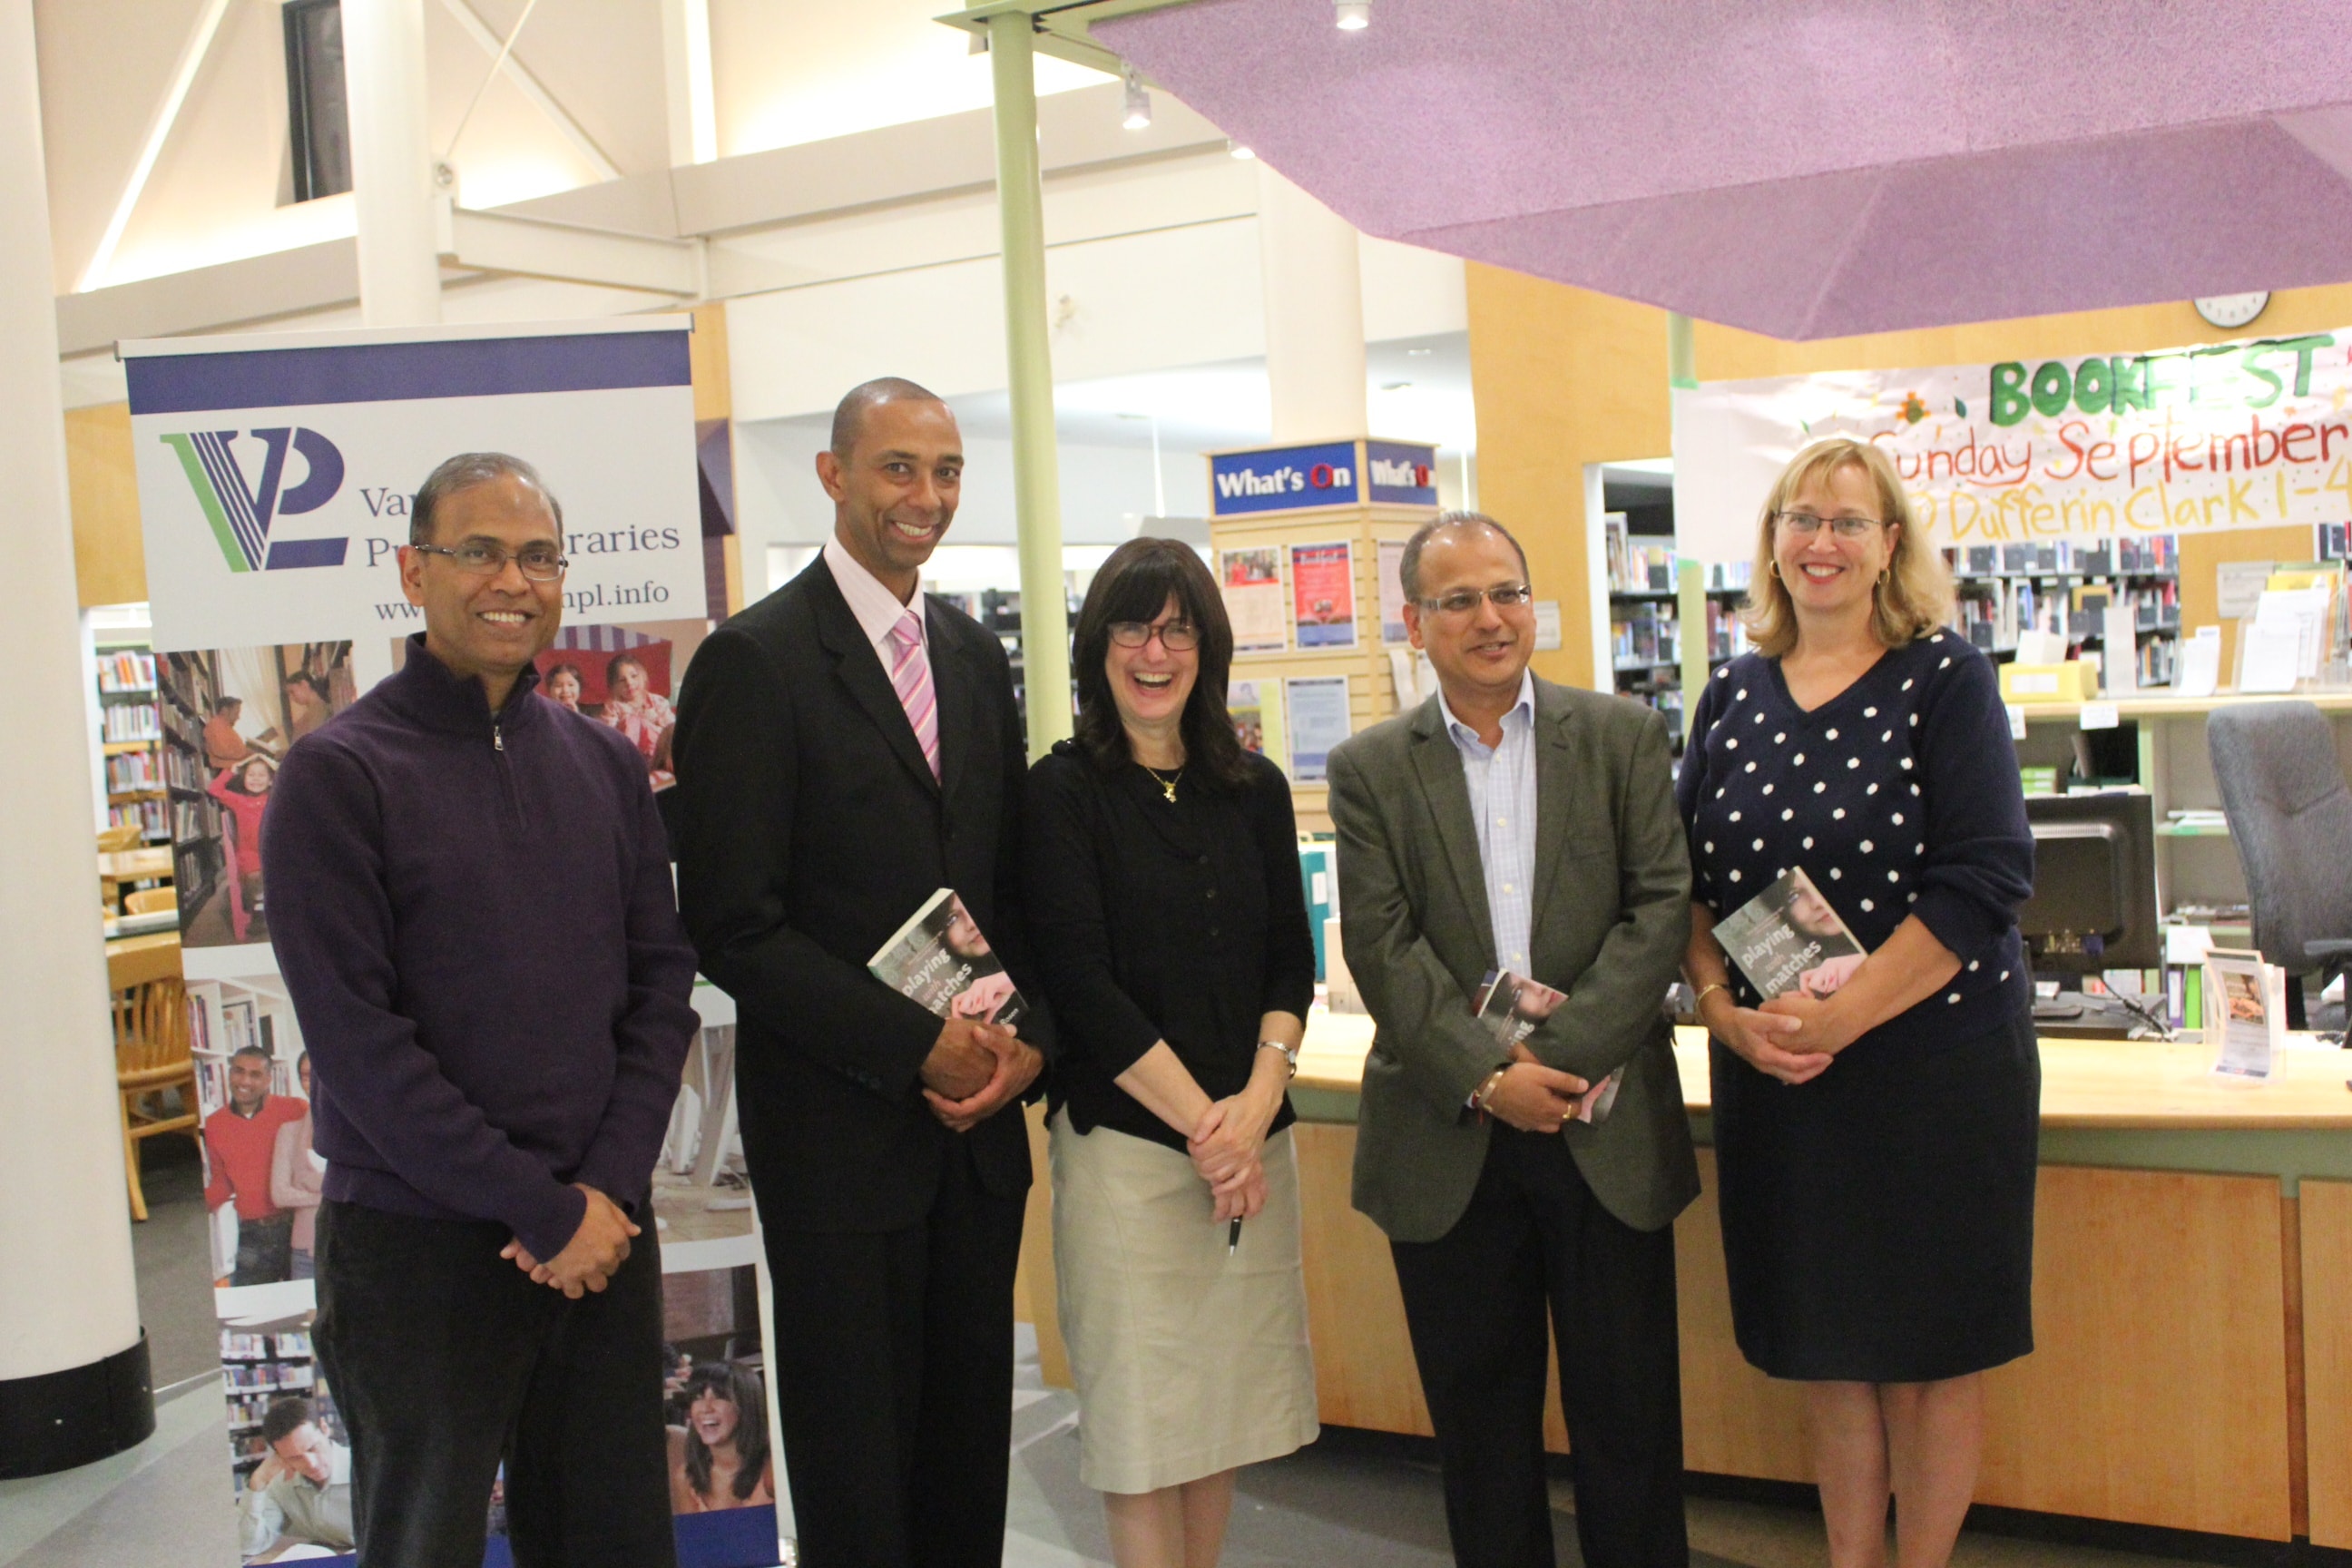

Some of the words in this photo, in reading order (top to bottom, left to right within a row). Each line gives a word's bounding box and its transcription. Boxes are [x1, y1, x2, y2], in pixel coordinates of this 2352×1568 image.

[1990, 333, 2336, 427] BOOKFEST
[2043, 405, 2350, 489] September
[1216, 466, 1305, 498] What's
[1309, 463, 1351, 489] On
[1949, 484, 2115, 541] Dufferin
[568, 524, 681, 556] raries
[901, 947, 952, 997] playing
[1740, 923, 1796, 970] playing
[1764, 940, 1822, 995] matches
